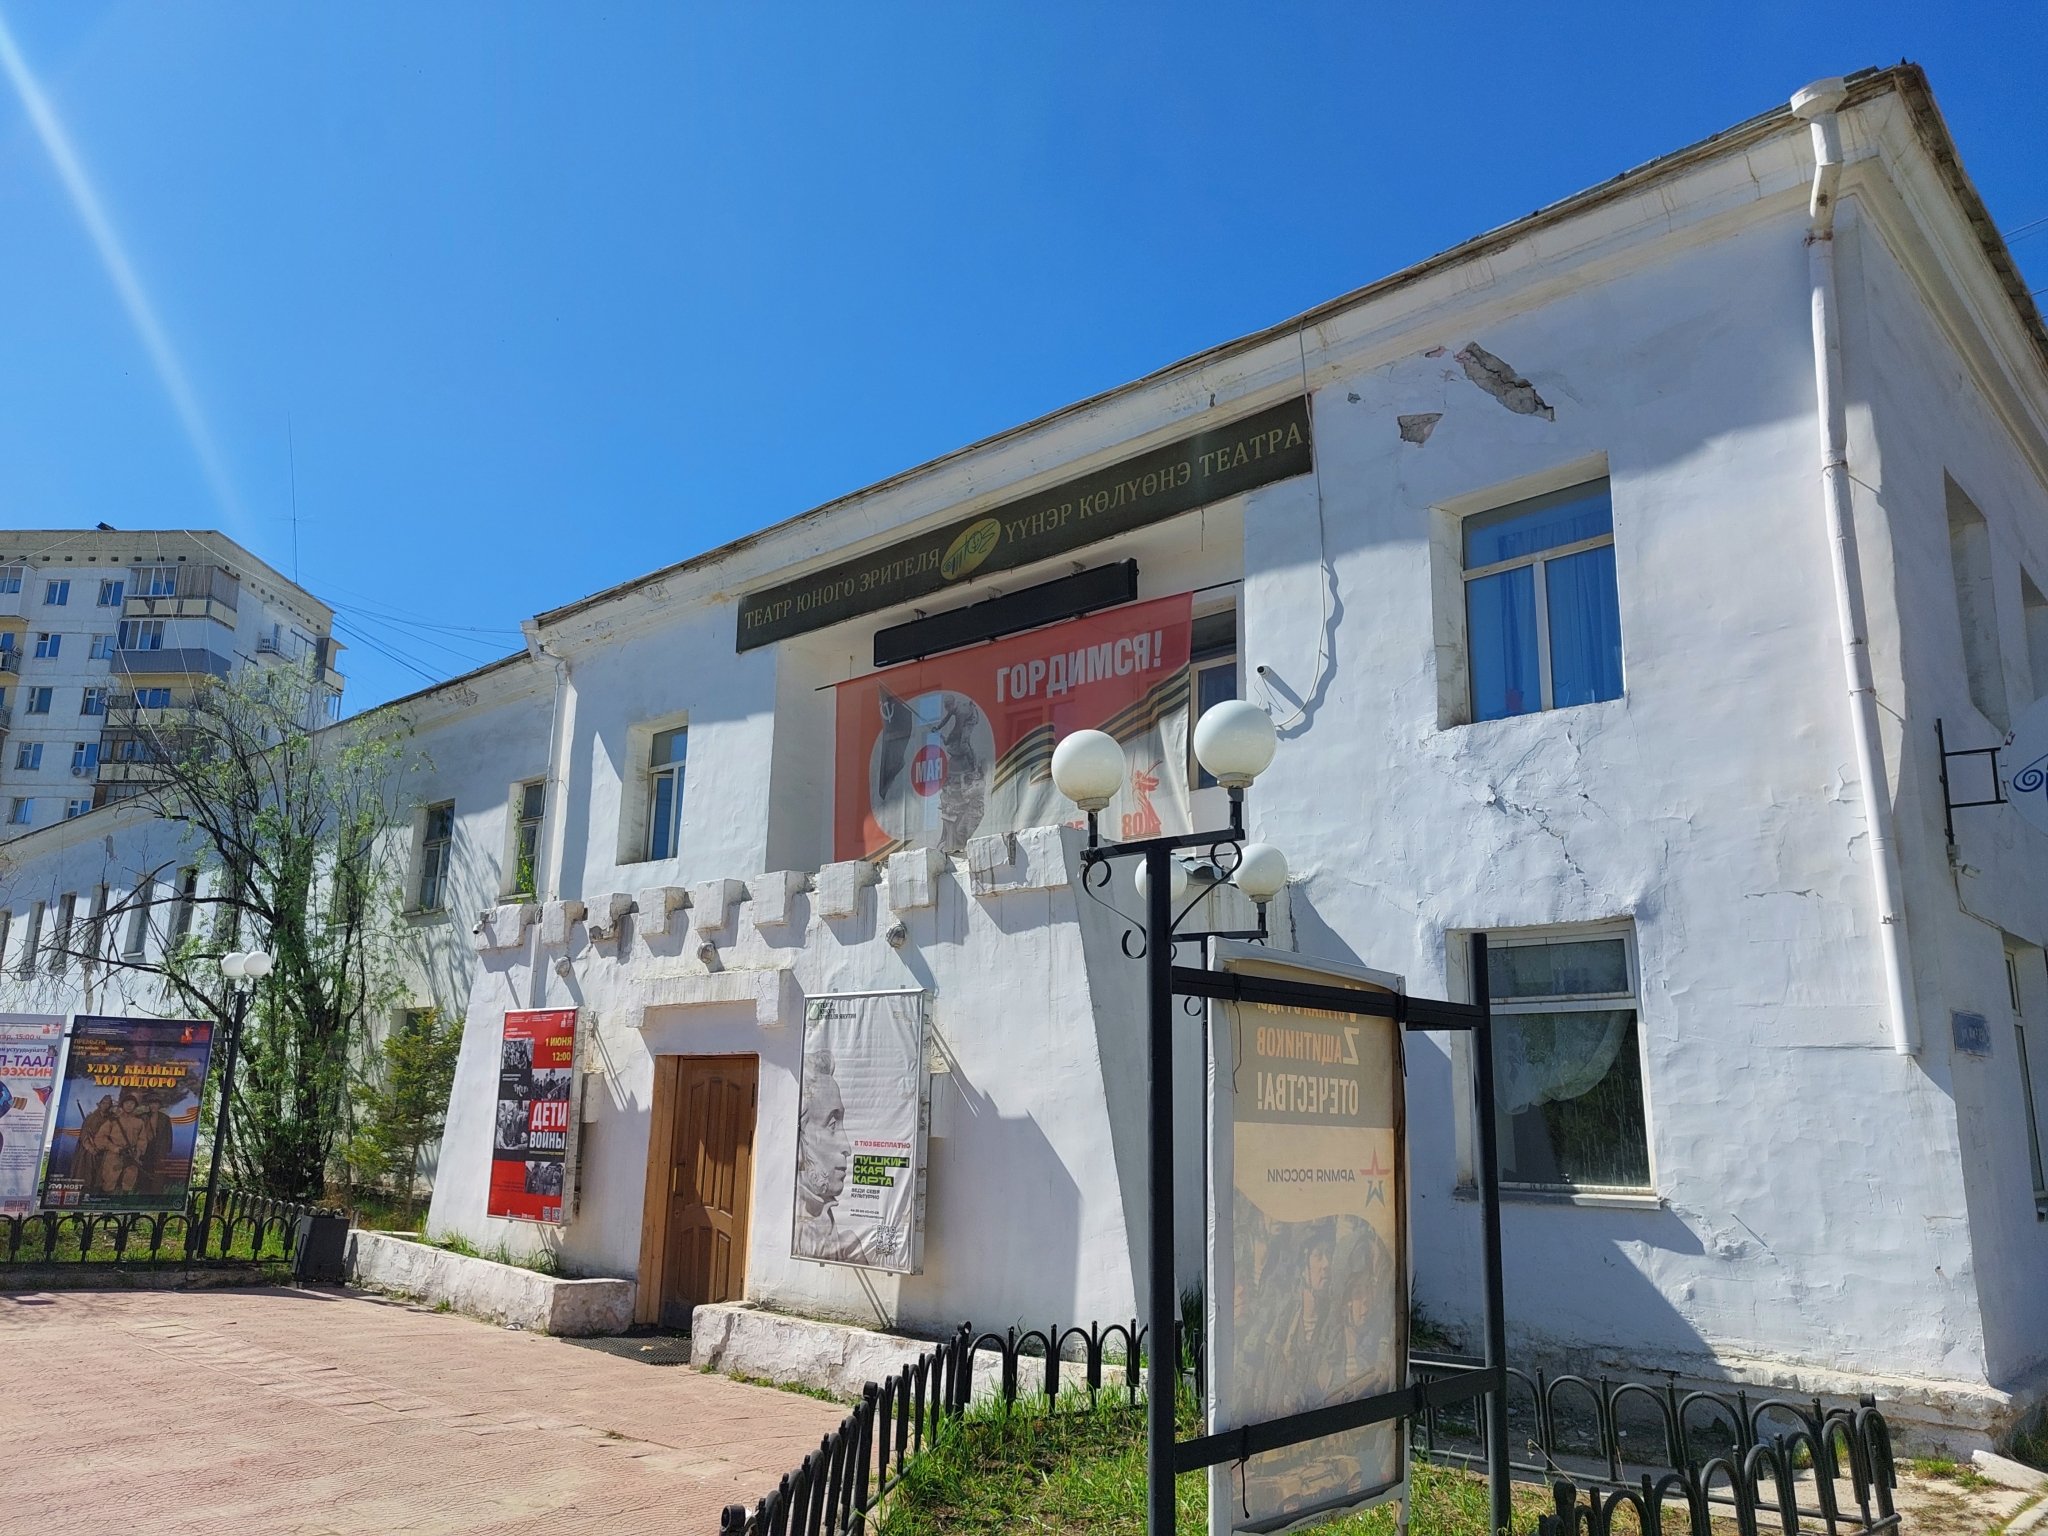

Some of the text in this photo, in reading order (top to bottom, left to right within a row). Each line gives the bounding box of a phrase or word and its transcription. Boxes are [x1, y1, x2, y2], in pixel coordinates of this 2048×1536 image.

[1005, 422, 1304, 544] ҮҮНЭР КӨЛҮӨНЭ ТЕАТРА
[744, 548, 940, 630] ТЕАТР ЮНОГО ЗРИТЕЛЯ
[996, 630, 1163, 703] ГОРДИМСЯ!
[915, 758, 943, 783] МАЯ
[1122, 812, 1144, 836] 80
[545, 1036, 573, 1047] 1 ИЮНЯ
[552, 1051, 571, 1062] 12:00
[0, 1067, 53, 1077] ЭЭХСИН
[87, 1063, 120, 1074] УЛУУ
[93, 1075, 177, 1088] ХОТОЙДОРО
[531, 1102, 568, 1130] ДЕТИ
[529, 1128, 566, 1150] ВОЙНЫ
[873, 1141, 911, 1149] БЕСПЛАТНО
[854, 1155, 909, 1168] ПУШКИН
[853, 1165, 884, 1175] СКАЯ
[853, 1175, 893, 1186] КАРТА
